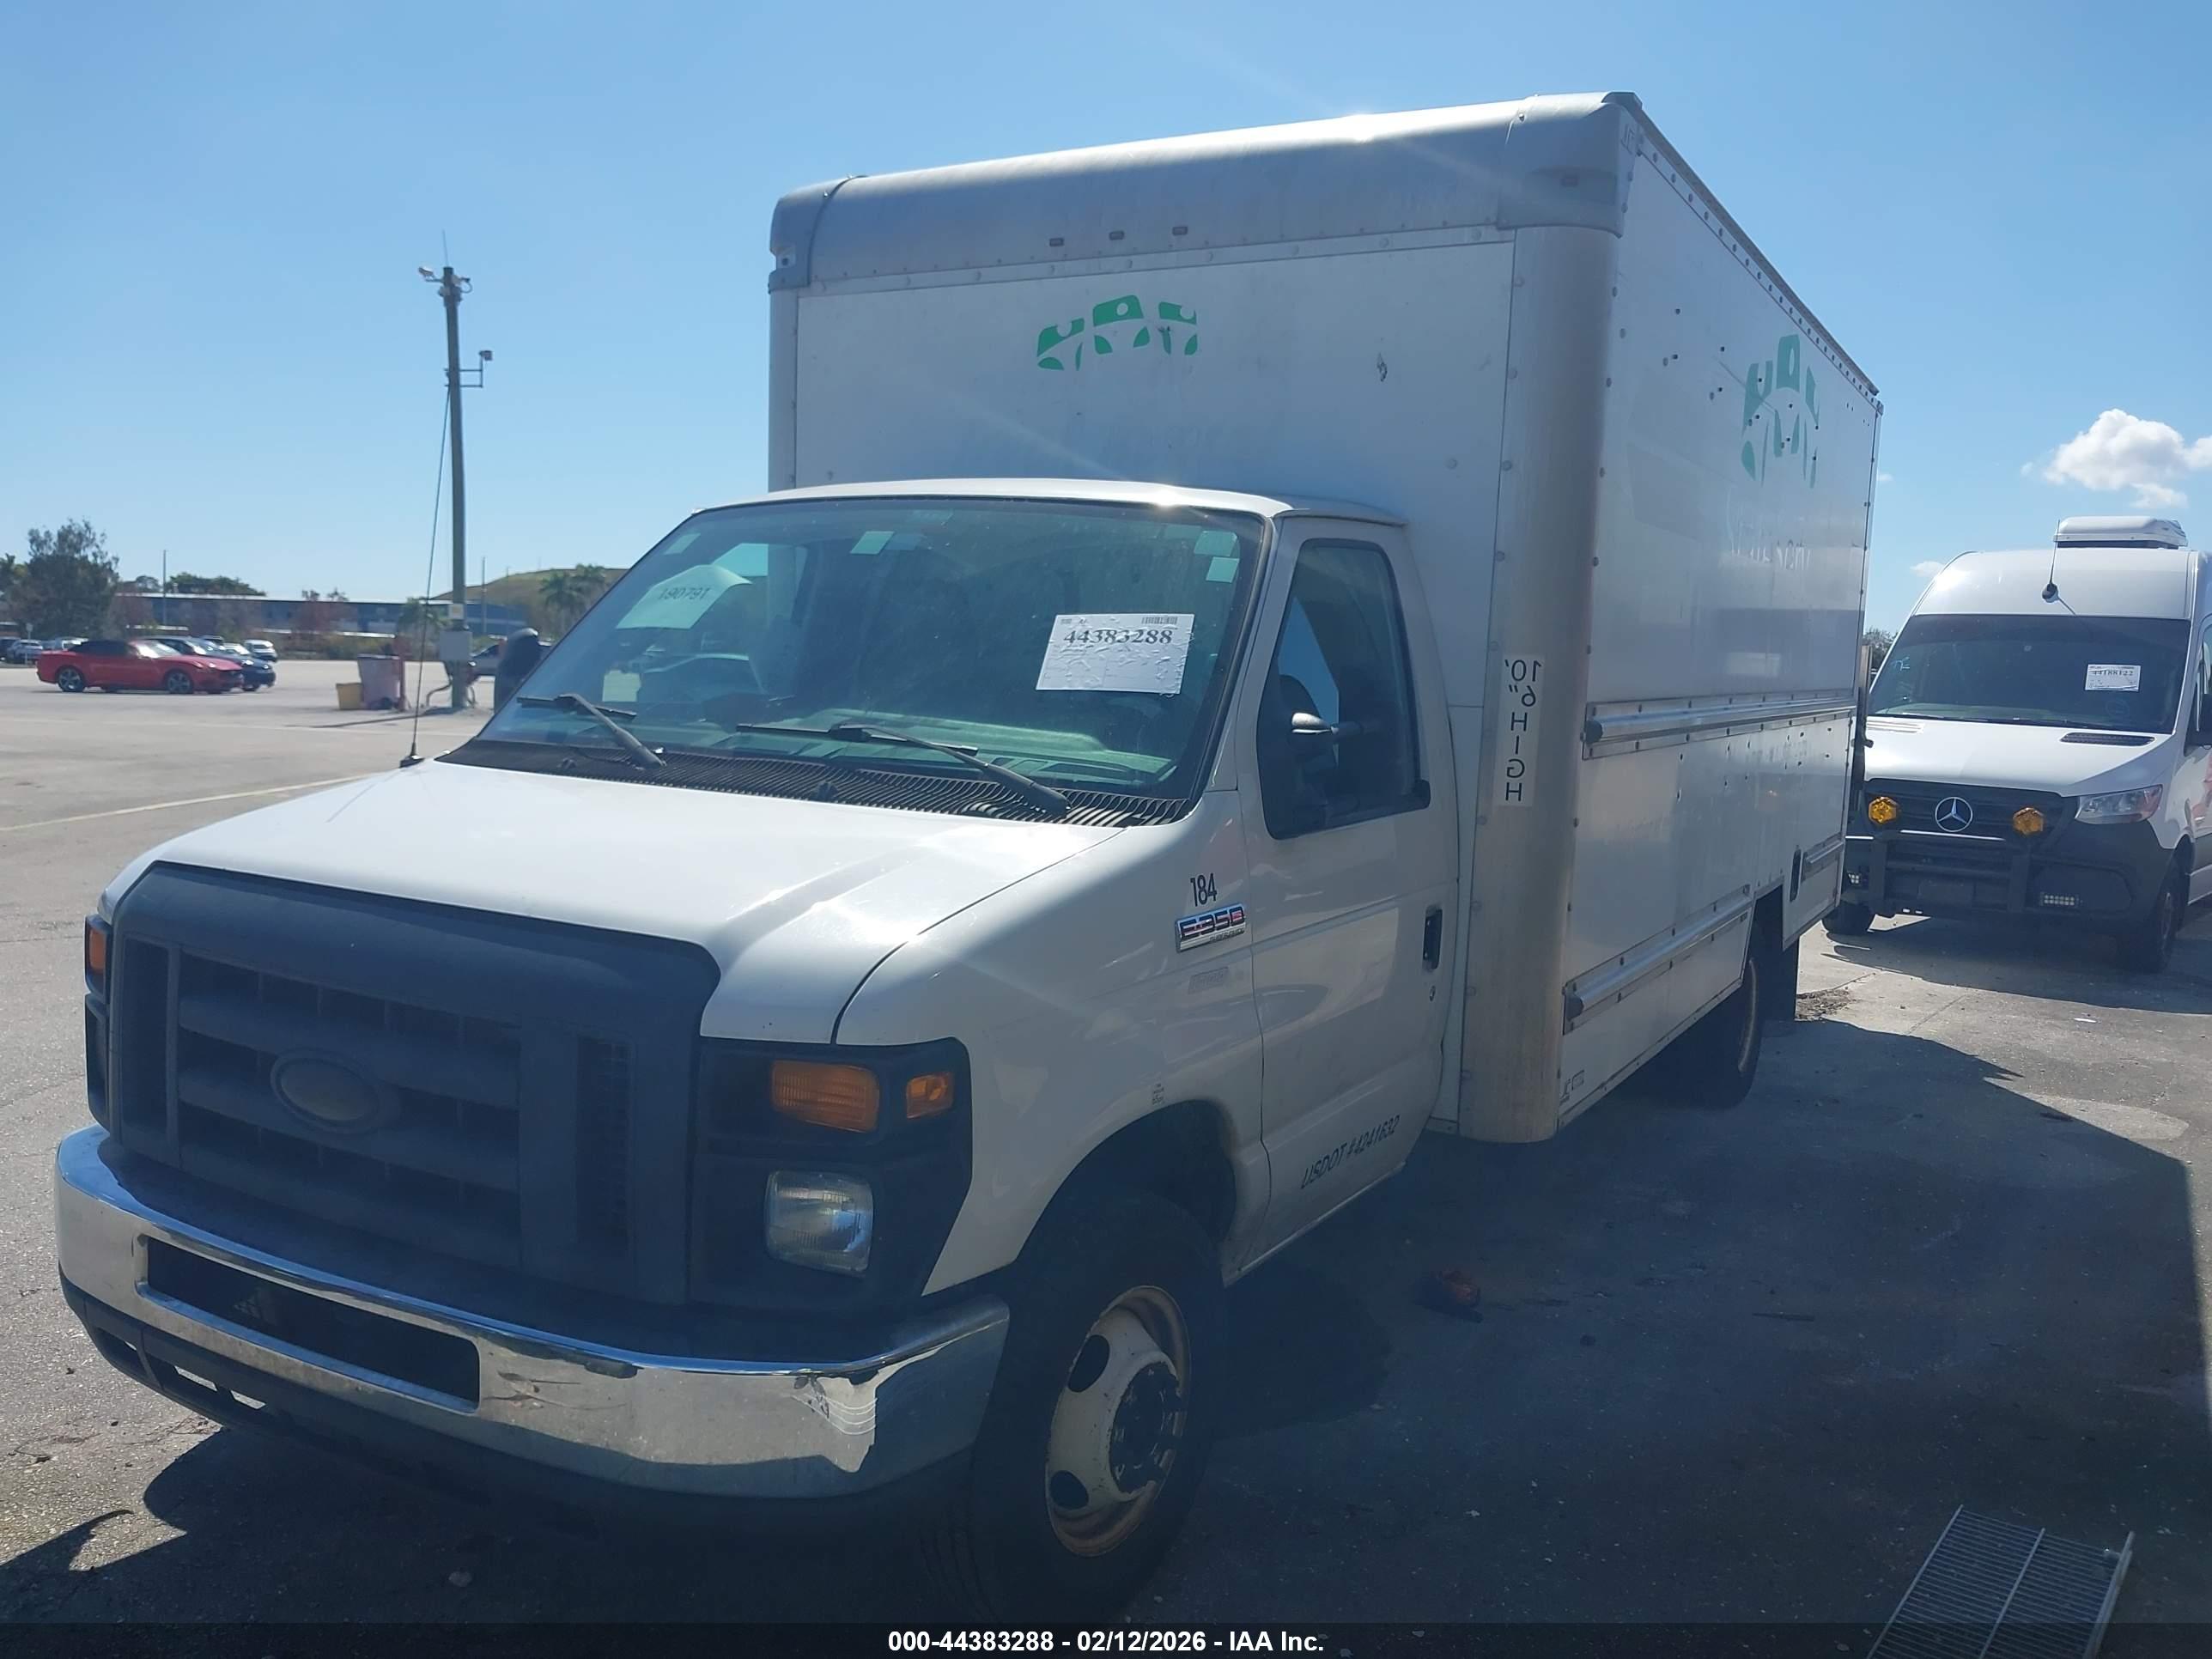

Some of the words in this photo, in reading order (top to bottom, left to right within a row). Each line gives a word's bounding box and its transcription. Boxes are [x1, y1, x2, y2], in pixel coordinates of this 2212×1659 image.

[1063, 629, 1173, 644] 44383288
[1190, 872, 1218, 907] 184
[1300, 1142, 1348, 1190] USDOT
